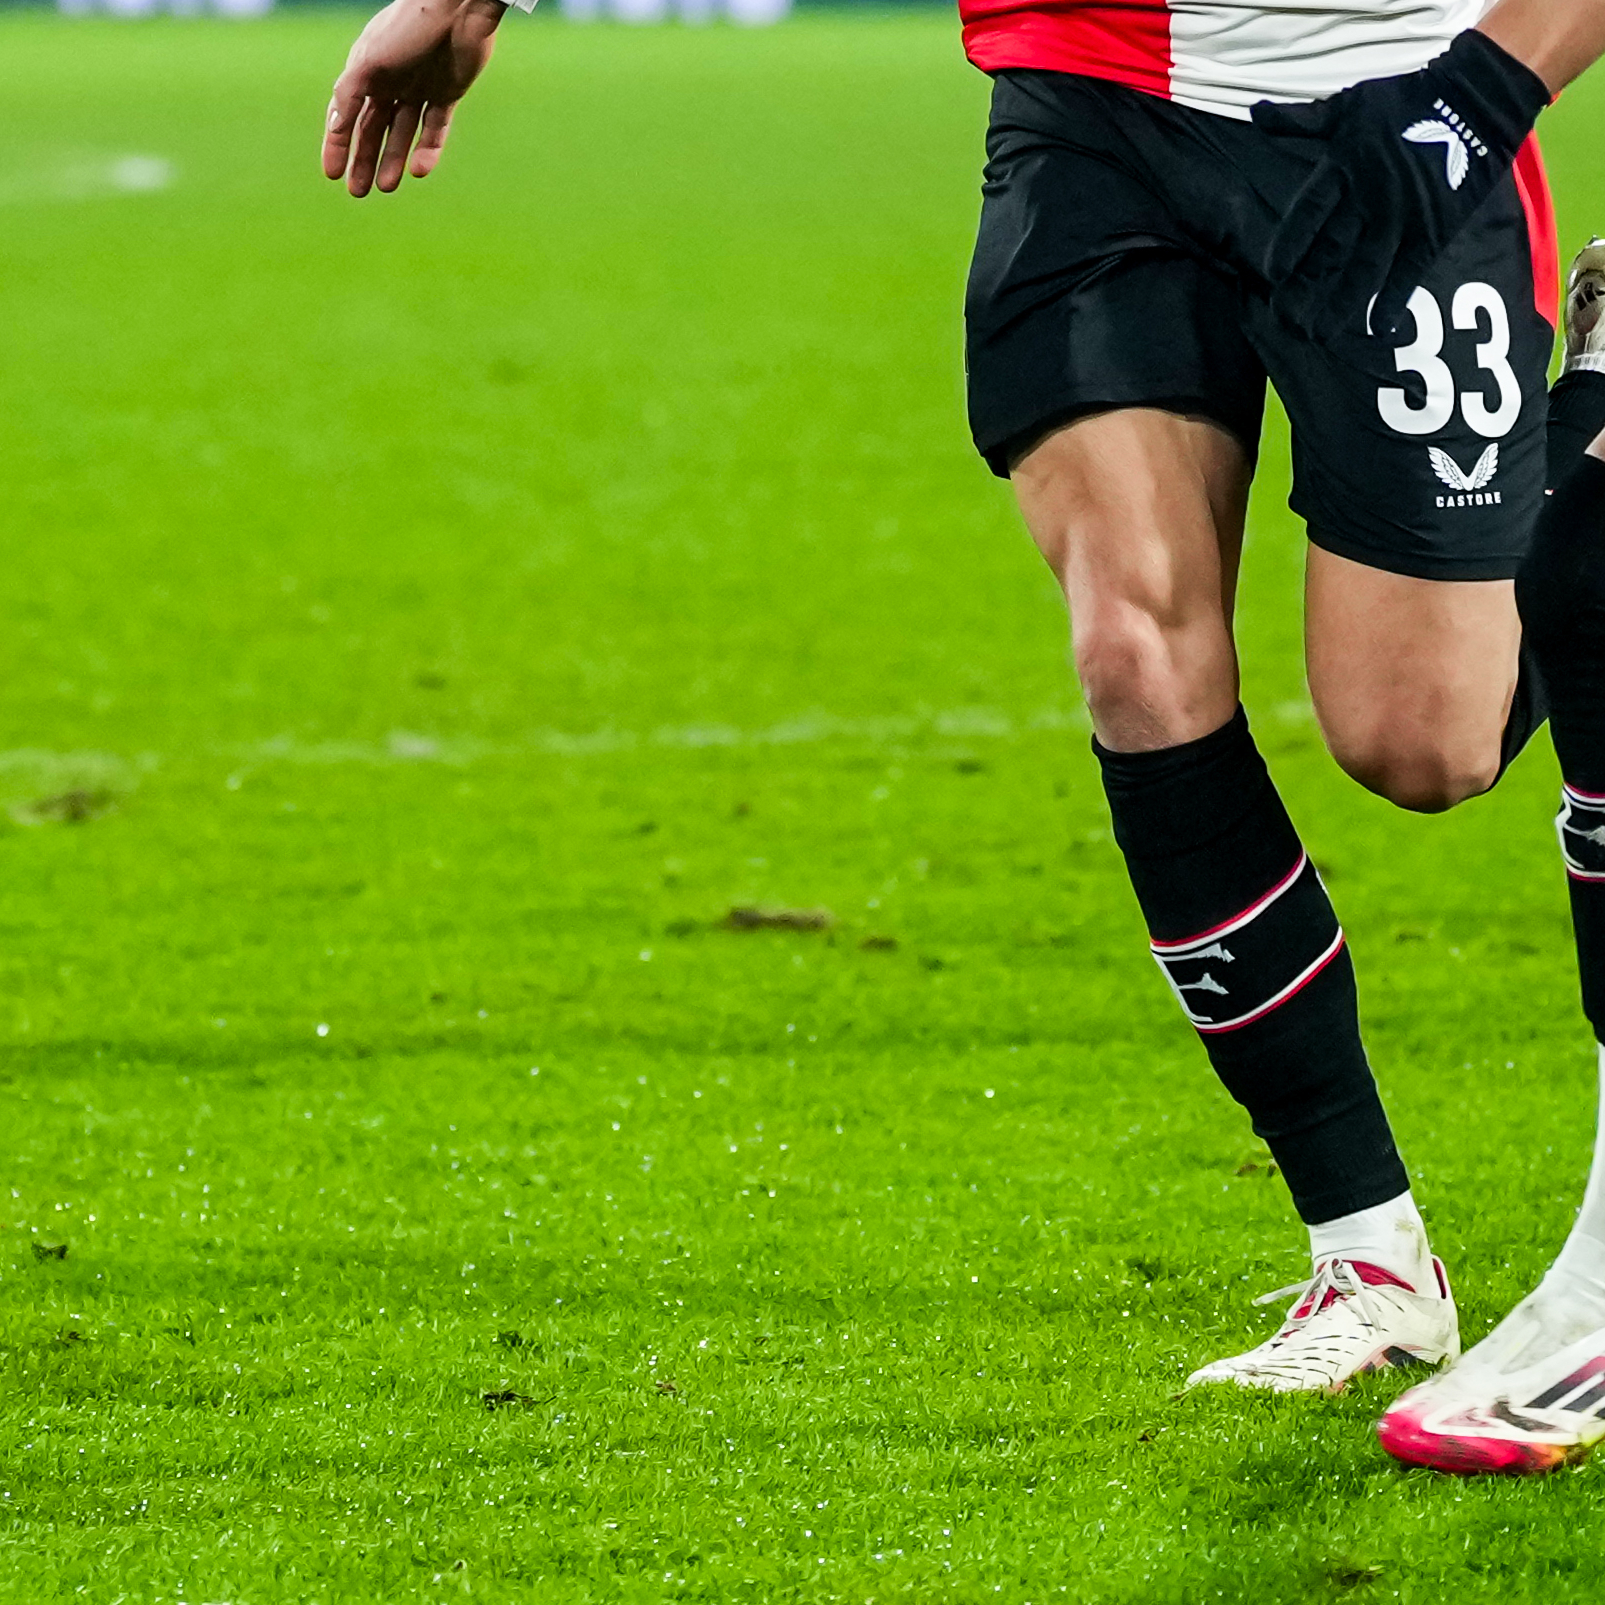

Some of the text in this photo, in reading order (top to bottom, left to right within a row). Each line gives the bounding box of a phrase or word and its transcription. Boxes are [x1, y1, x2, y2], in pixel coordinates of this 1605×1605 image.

[1433, 97, 1488, 157] CASTORE
[1366, 281, 1522, 438] 33
[1436, 491, 1502, 508] CASTORE
